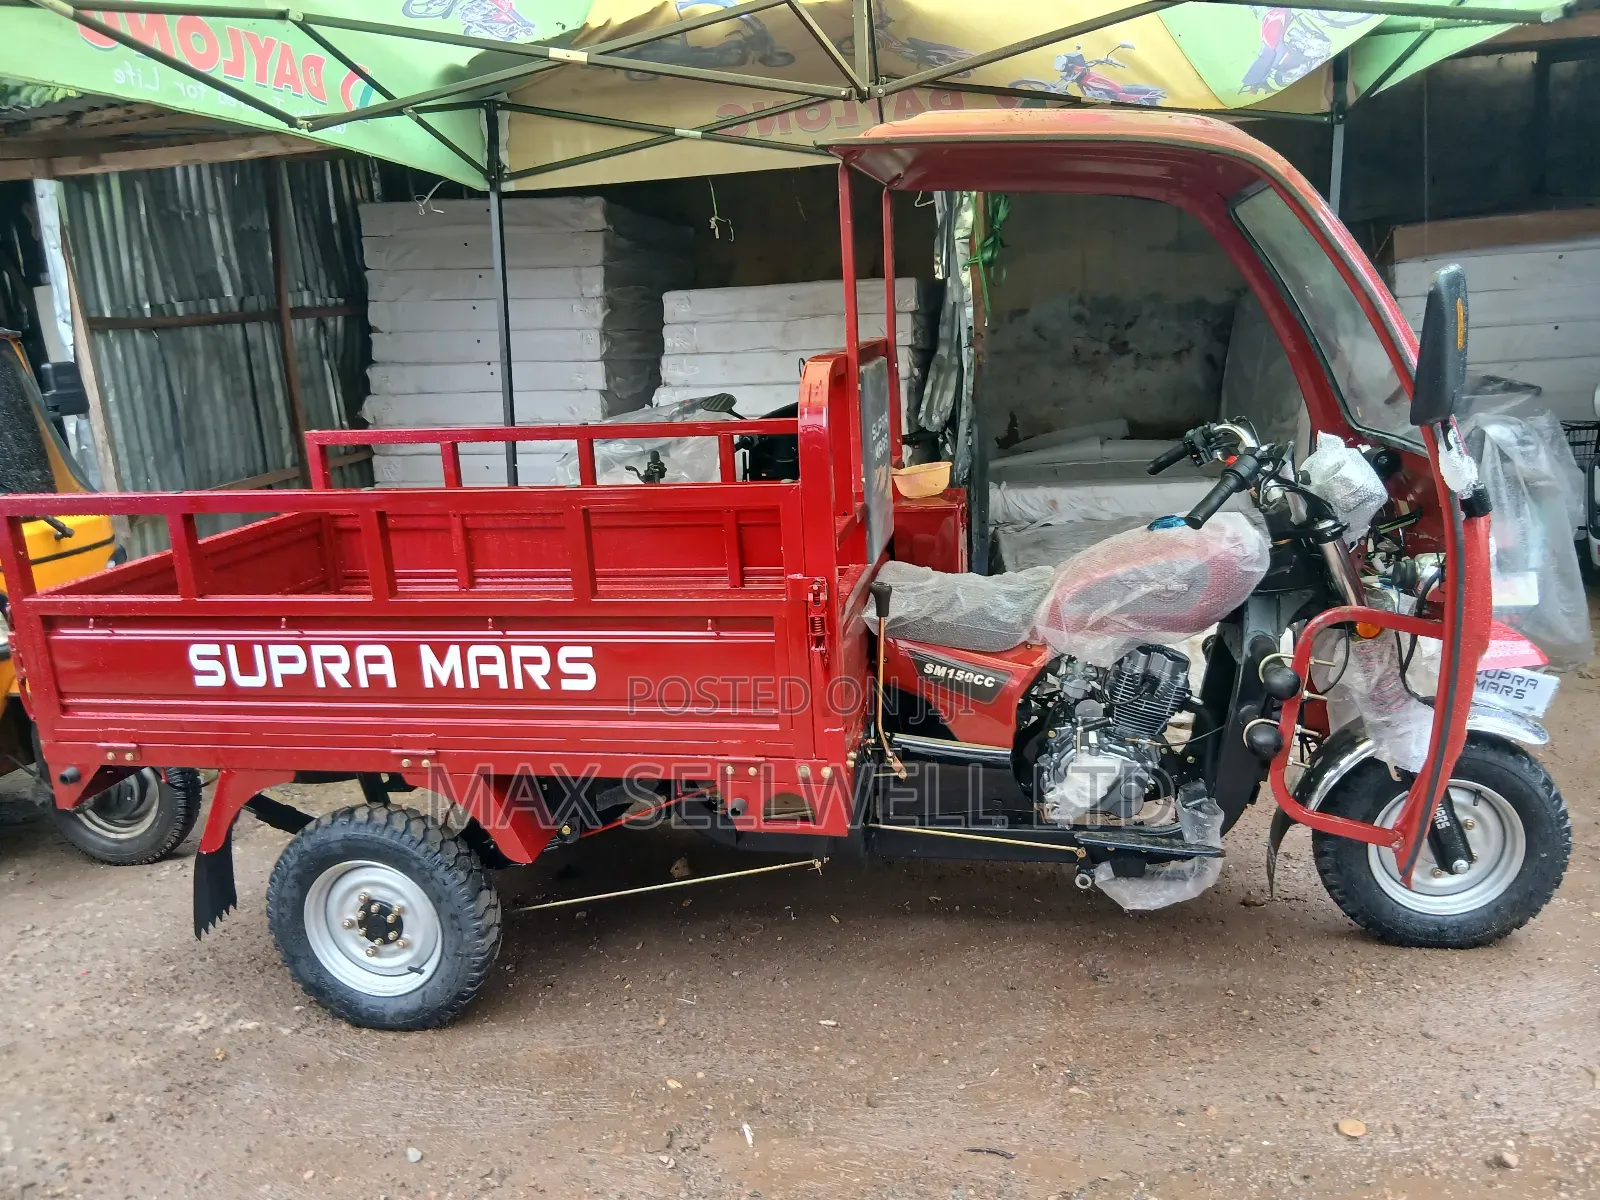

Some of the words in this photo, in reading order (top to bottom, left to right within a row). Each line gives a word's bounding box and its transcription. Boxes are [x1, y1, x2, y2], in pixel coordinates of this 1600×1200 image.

[188, 643, 398, 688] SUPRA
[419, 644, 598, 691] MARS
[923, 662, 996, 688] SM150CC
[1475, 678, 1527, 700] MARS
